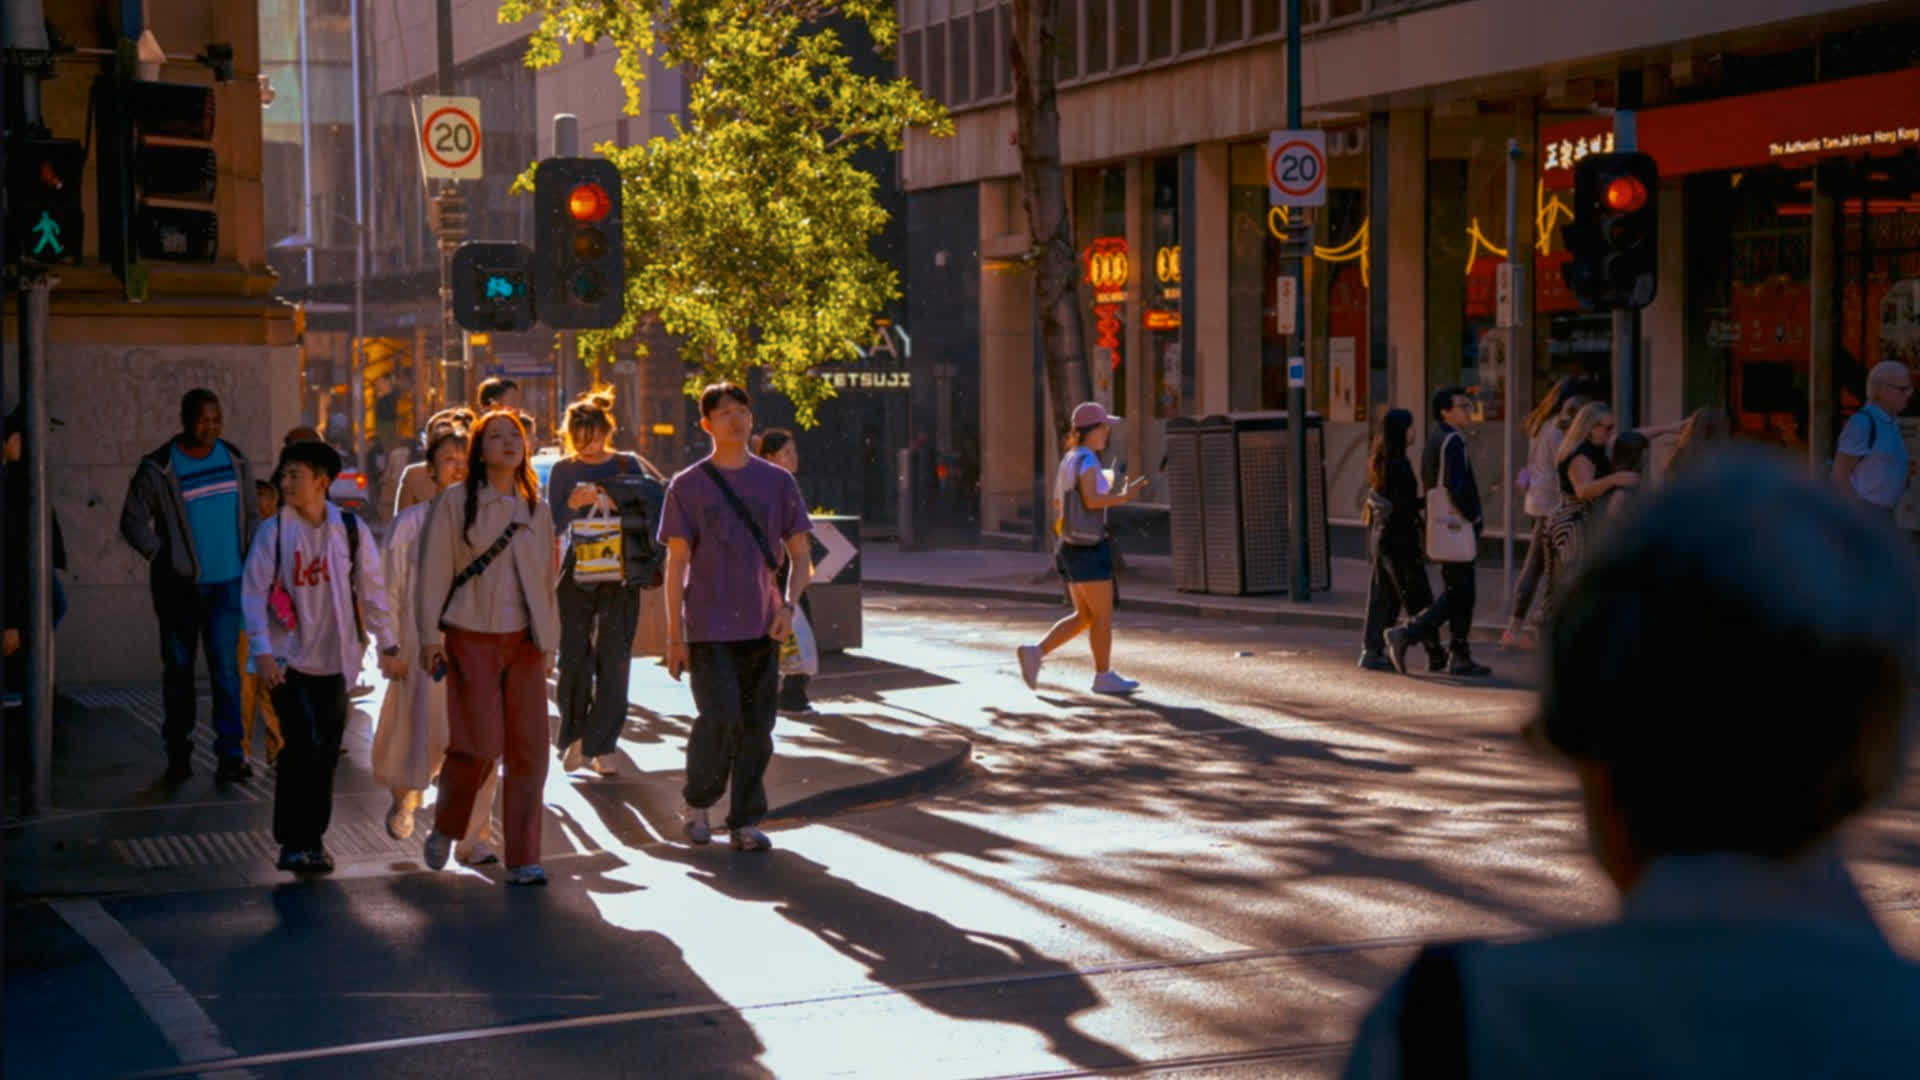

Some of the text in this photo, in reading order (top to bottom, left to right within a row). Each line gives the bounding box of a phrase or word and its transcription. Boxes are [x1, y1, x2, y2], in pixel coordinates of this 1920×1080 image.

[435, 123, 472, 152] 20
[1785, 139, 1820, 153] Authentic
[1874, 130, 1896, 144] Hong
[1897, 127, 1919, 142] Kong
[1282, 155, 1317, 181] 20
[821, 372, 911, 388] TETSUJI
